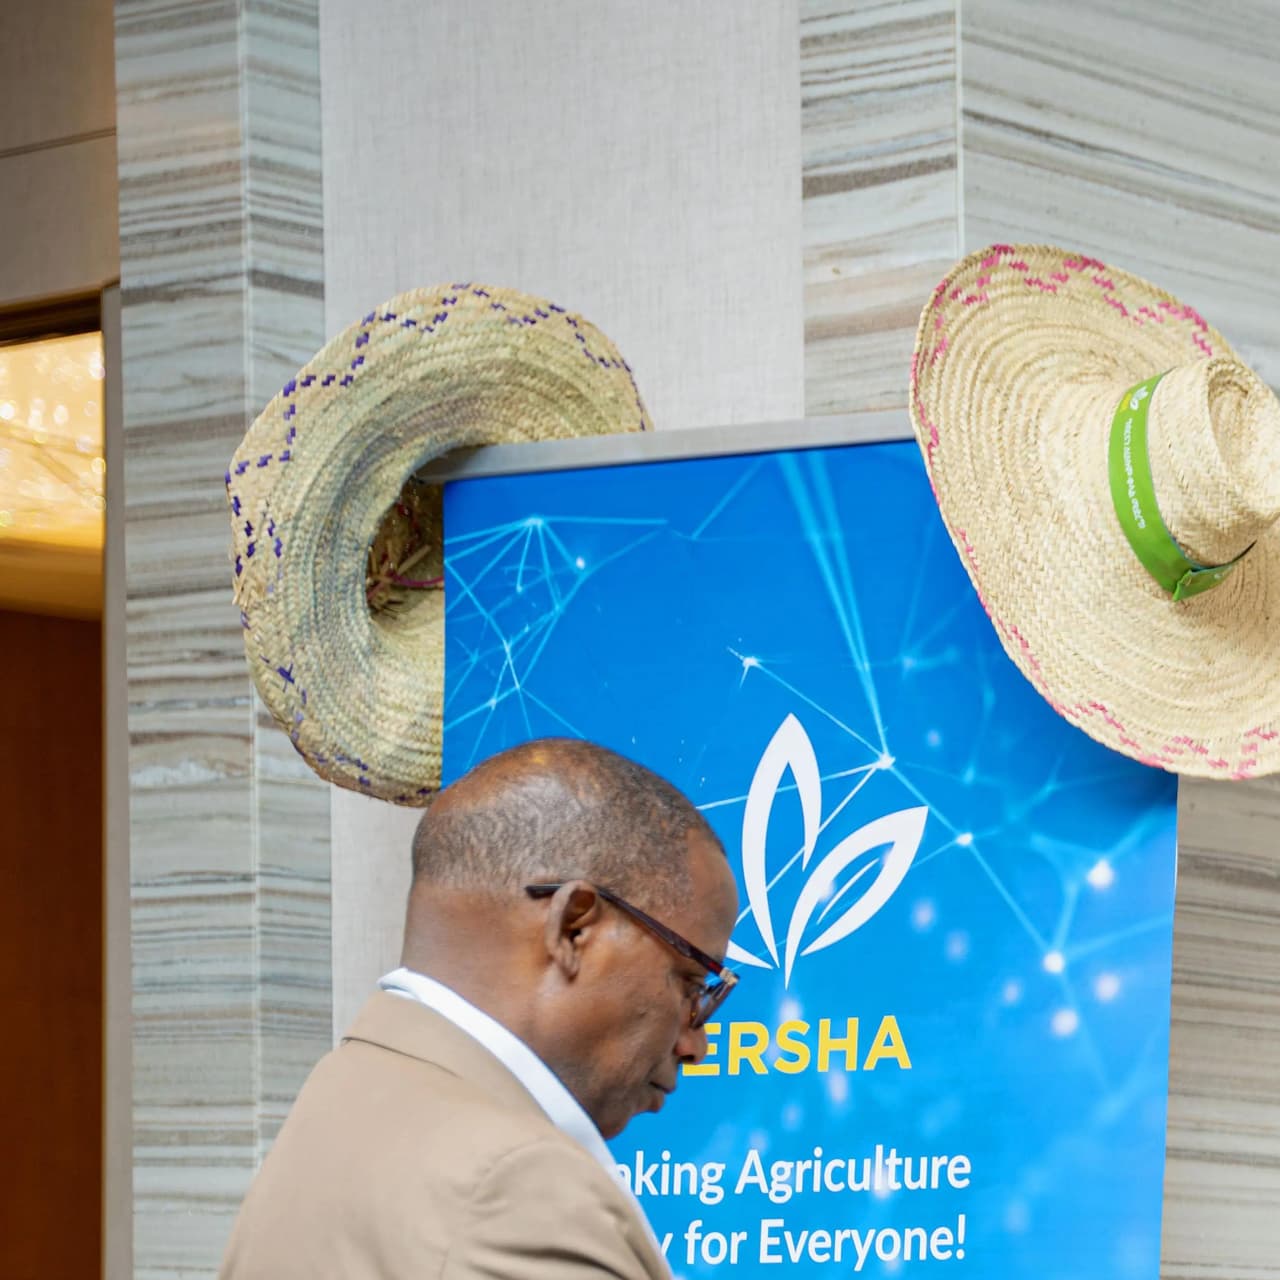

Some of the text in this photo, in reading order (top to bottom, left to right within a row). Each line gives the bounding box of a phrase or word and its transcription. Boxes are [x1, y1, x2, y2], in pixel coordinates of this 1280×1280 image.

[682, 1016, 912, 1076] ERSHA
[734, 1144, 971, 1204] Agriculture
[685, 1219, 747, 1265] for
[759, 1214, 966, 1272] Everyone!
